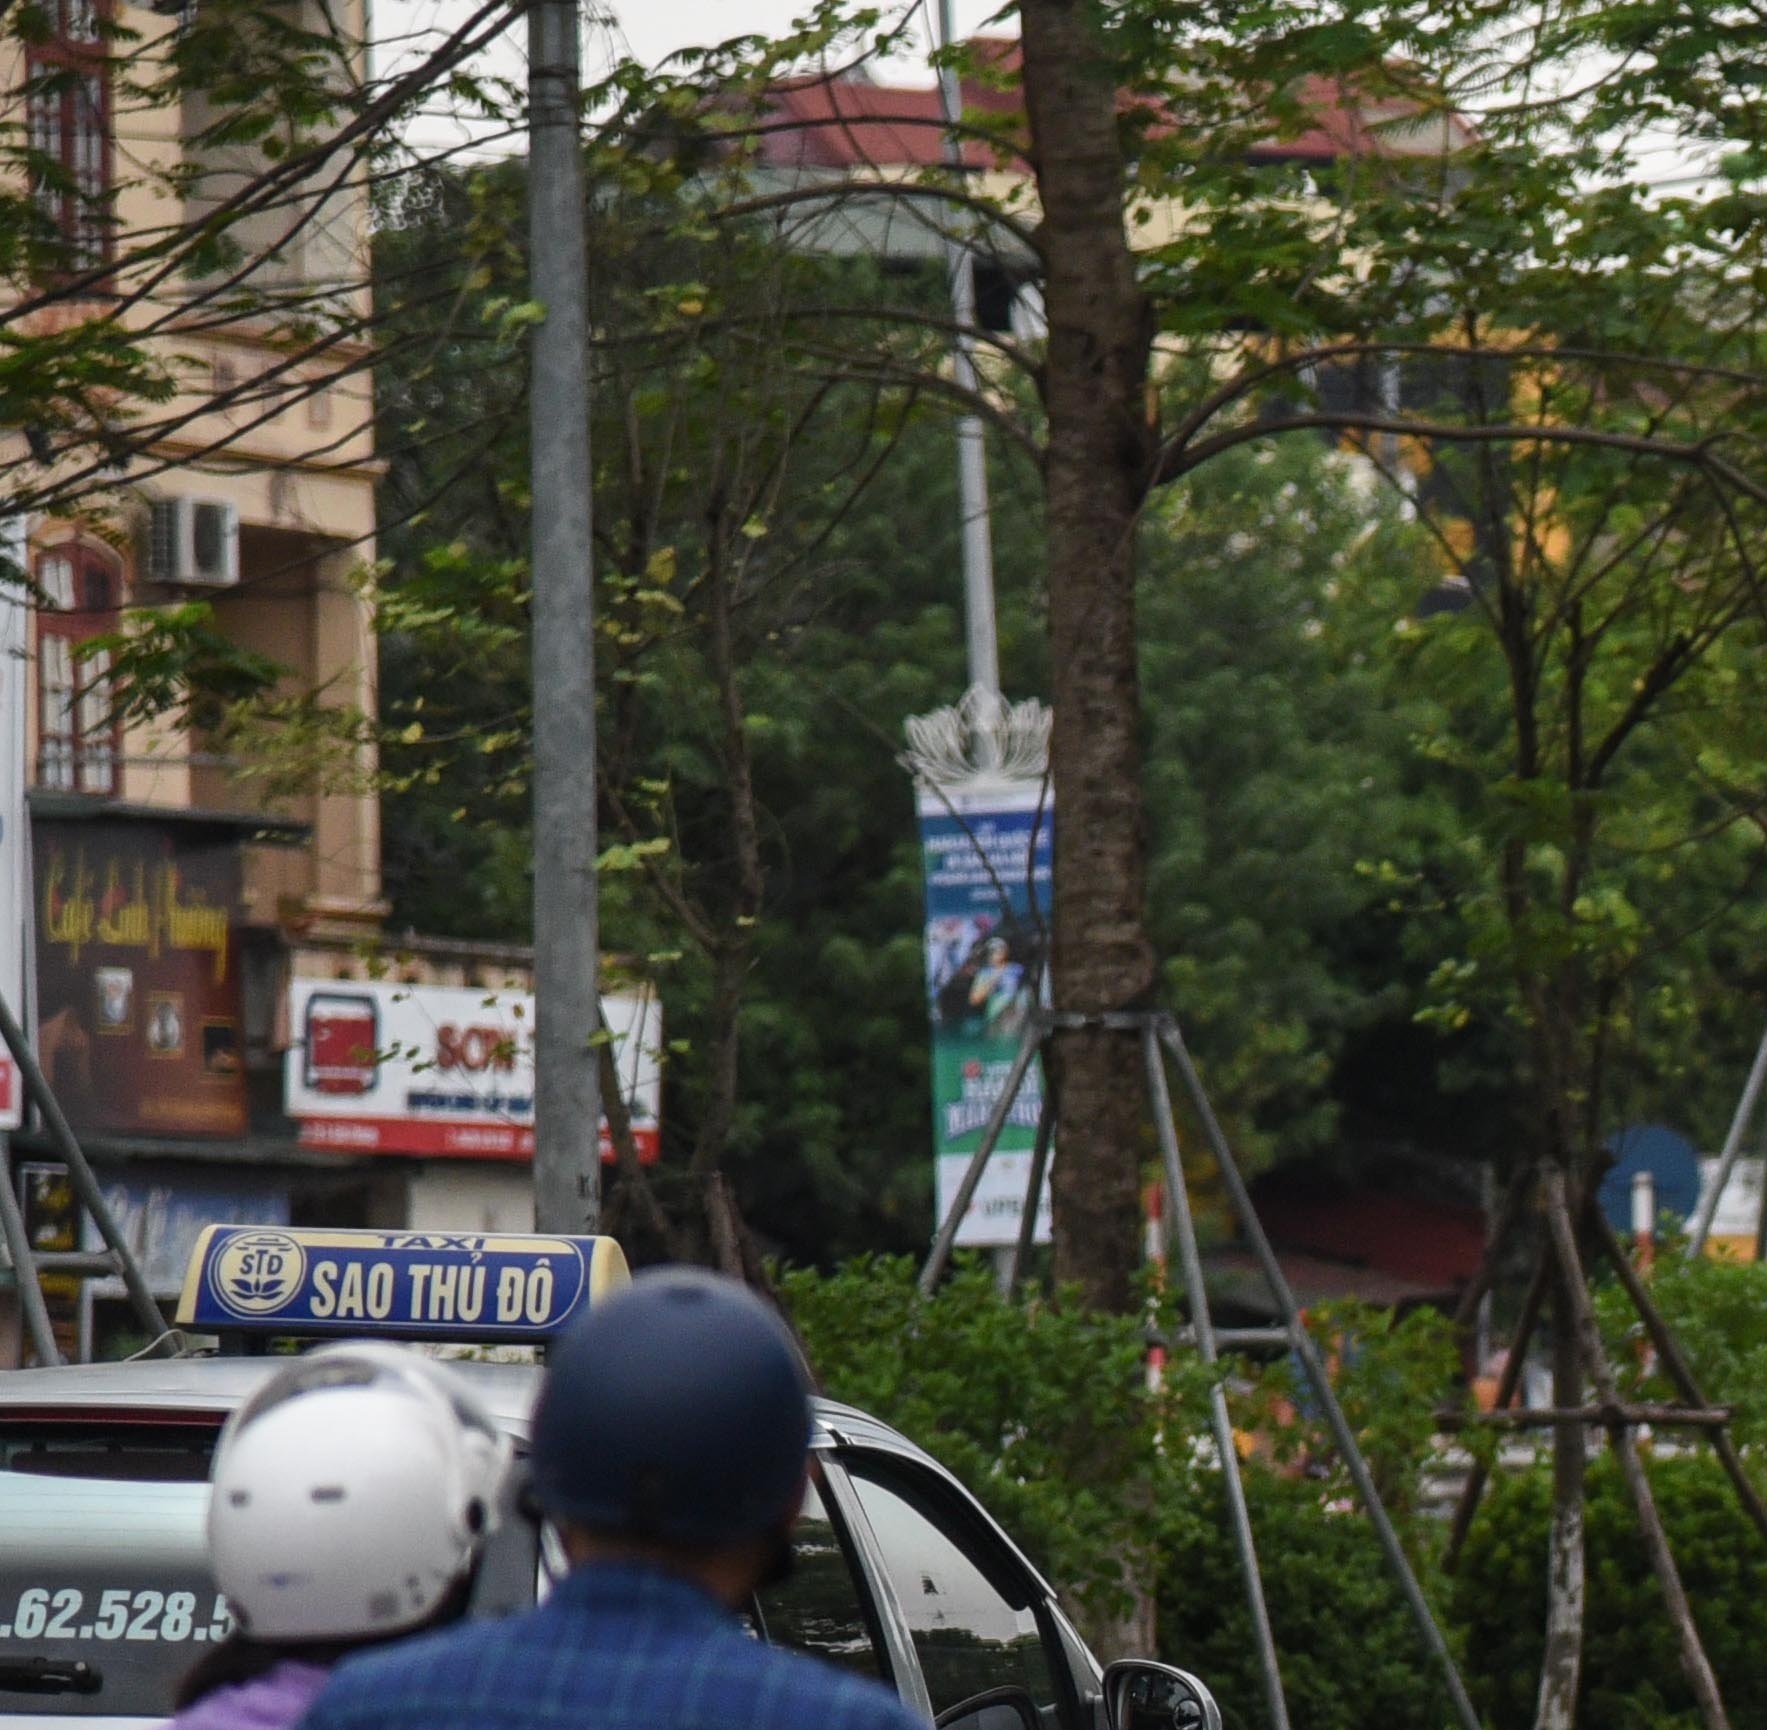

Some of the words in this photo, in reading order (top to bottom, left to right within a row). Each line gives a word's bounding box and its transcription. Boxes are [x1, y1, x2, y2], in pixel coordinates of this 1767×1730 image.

[378, 1235, 487, 1251] TAXI
[309, 1261, 396, 1320] SAO
[409, 1252, 487, 1323] THỦ
[496, 1258, 554, 1325] ĐÔ
